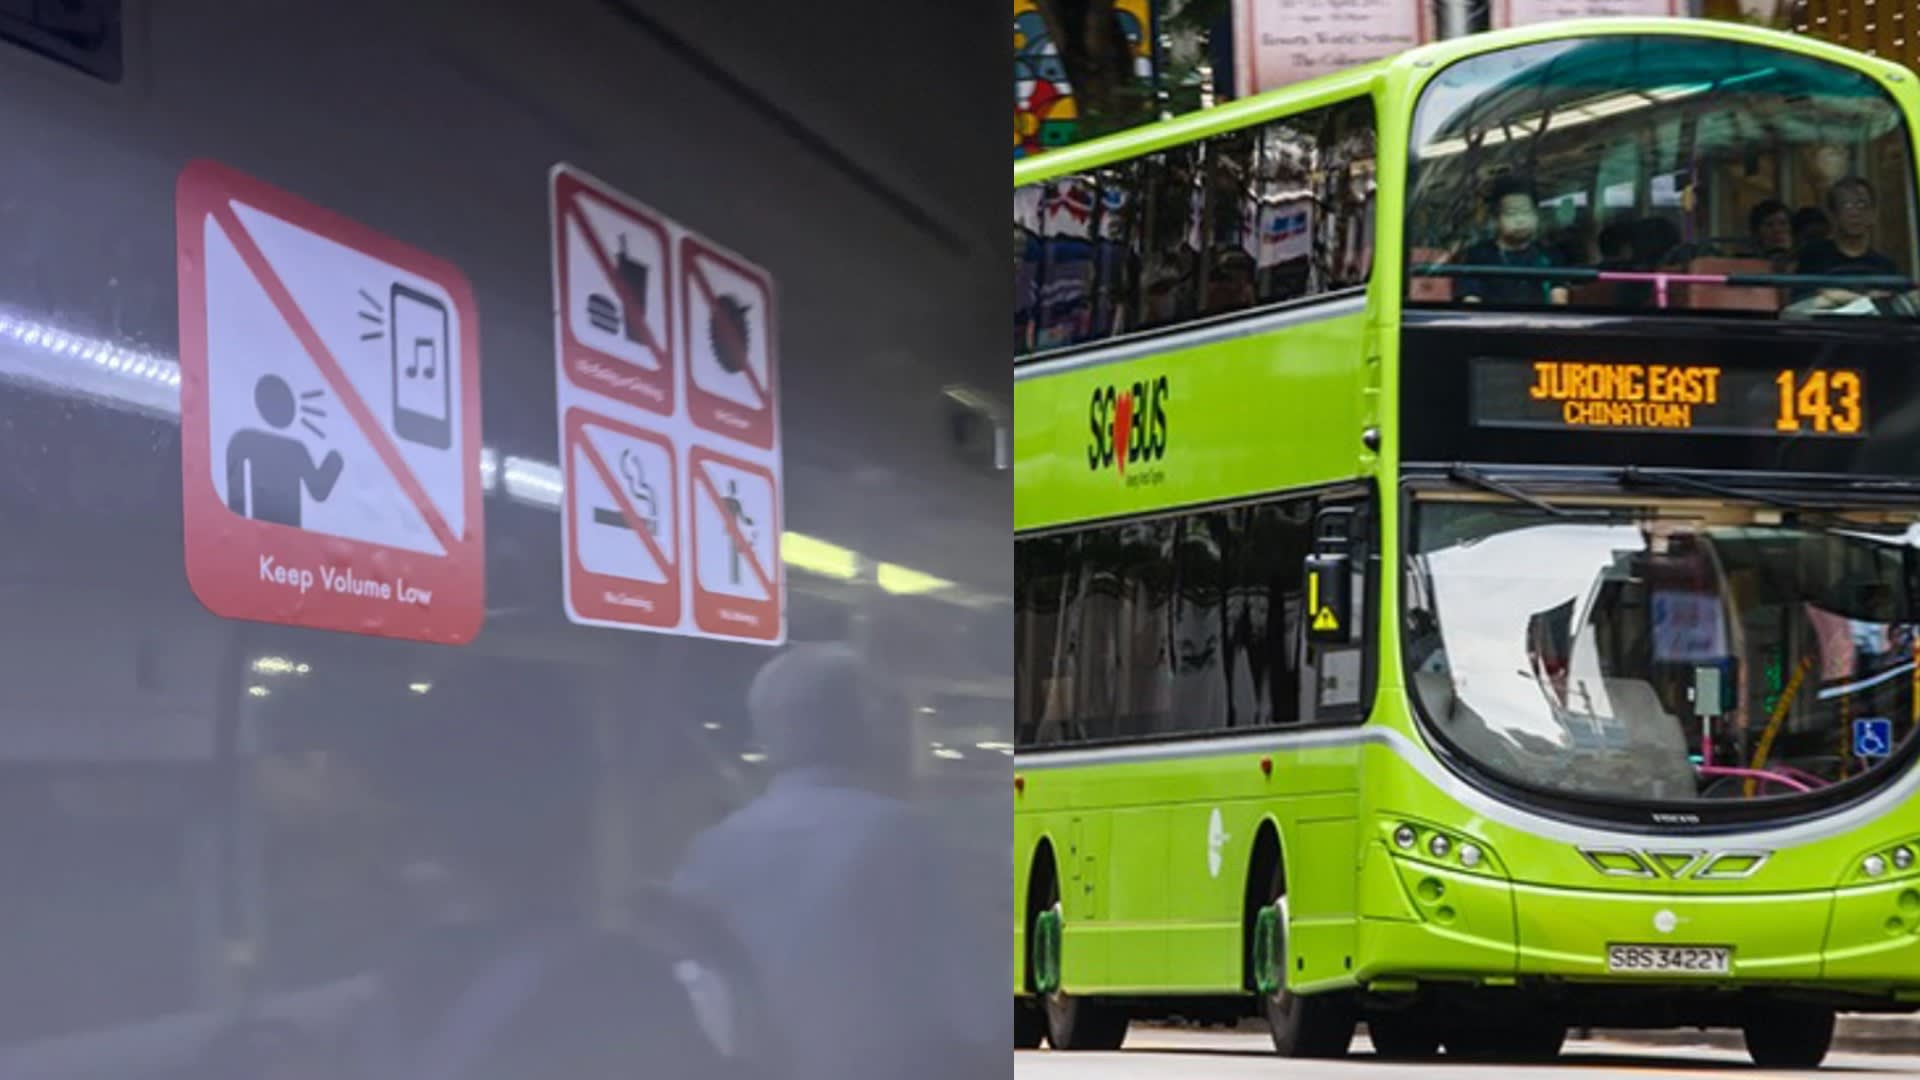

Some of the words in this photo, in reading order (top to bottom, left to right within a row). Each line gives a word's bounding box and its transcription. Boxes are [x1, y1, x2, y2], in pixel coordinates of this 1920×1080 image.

[1529, 361, 1646, 401] JURONG
[1648, 365, 1720, 404] EAST
[1776, 370, 1862, 434] 143
[1563, 401, 1691, 428] CHINATOWN
[259, 554, 313, 593] Keep
[320, 565, 391, 600] Volume
[396, 577, 432, 605] Low
